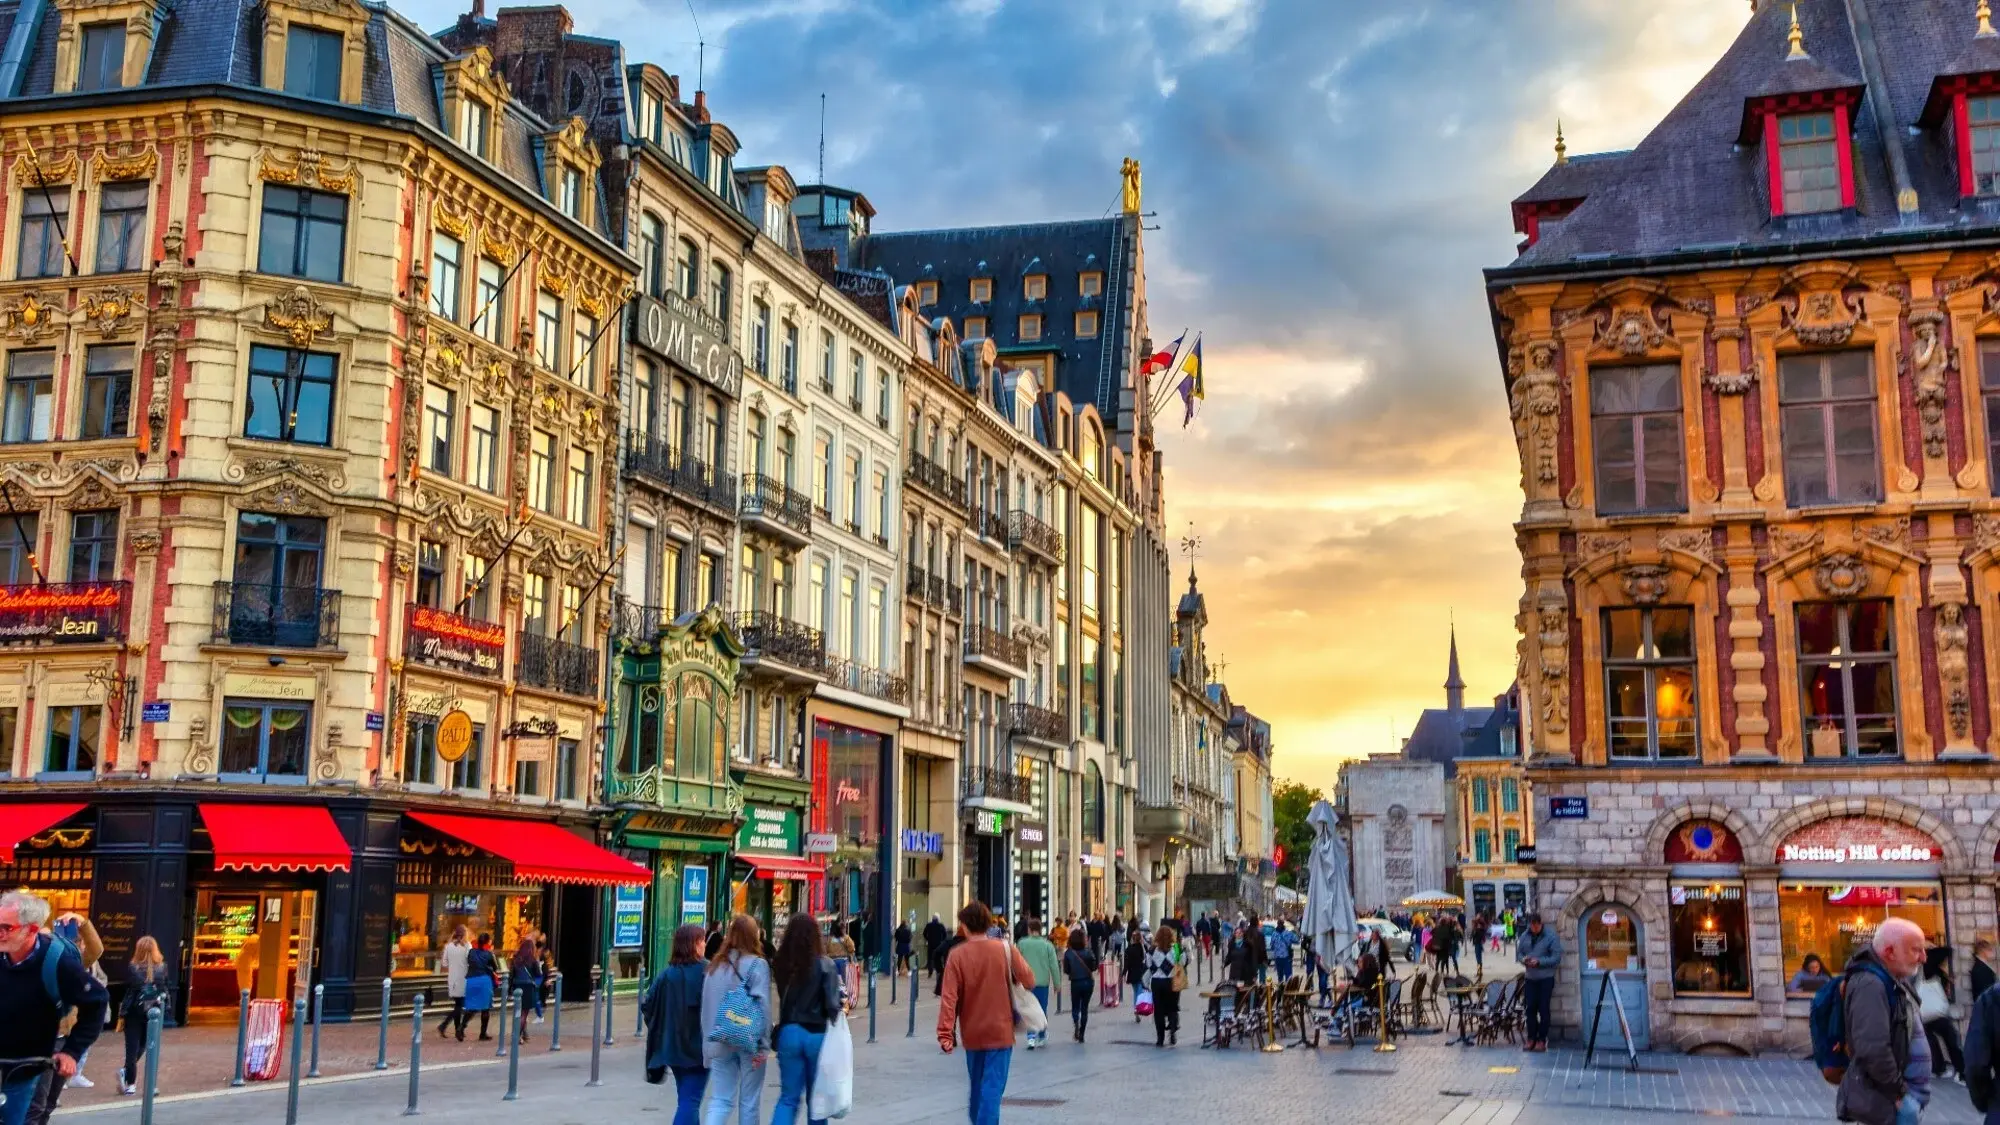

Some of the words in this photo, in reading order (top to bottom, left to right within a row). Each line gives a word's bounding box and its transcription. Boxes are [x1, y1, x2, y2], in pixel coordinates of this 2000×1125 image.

[673, 297, 721, 338] MONTRE
[648, 304, 736, 393] OMEGA
[56, 616, 98, 636] Jean
[472, 648, 497, 670] Jean
[684, 640, 714, 665] Cloche
[278, 685, 304, 696] Jean
[441, 727, 469, 743] PAUL
[836, 780, 860, 805] free
[810, 838, 833, 849] free
[1784, 844, 1846, 863] Notting
[1849, 844, 1879, 861] Hill
[1881, 844, 1931, 861] coffee
[107, 882, 133, 893] PAUL
[1719, 887, 1740, 900] Hill
